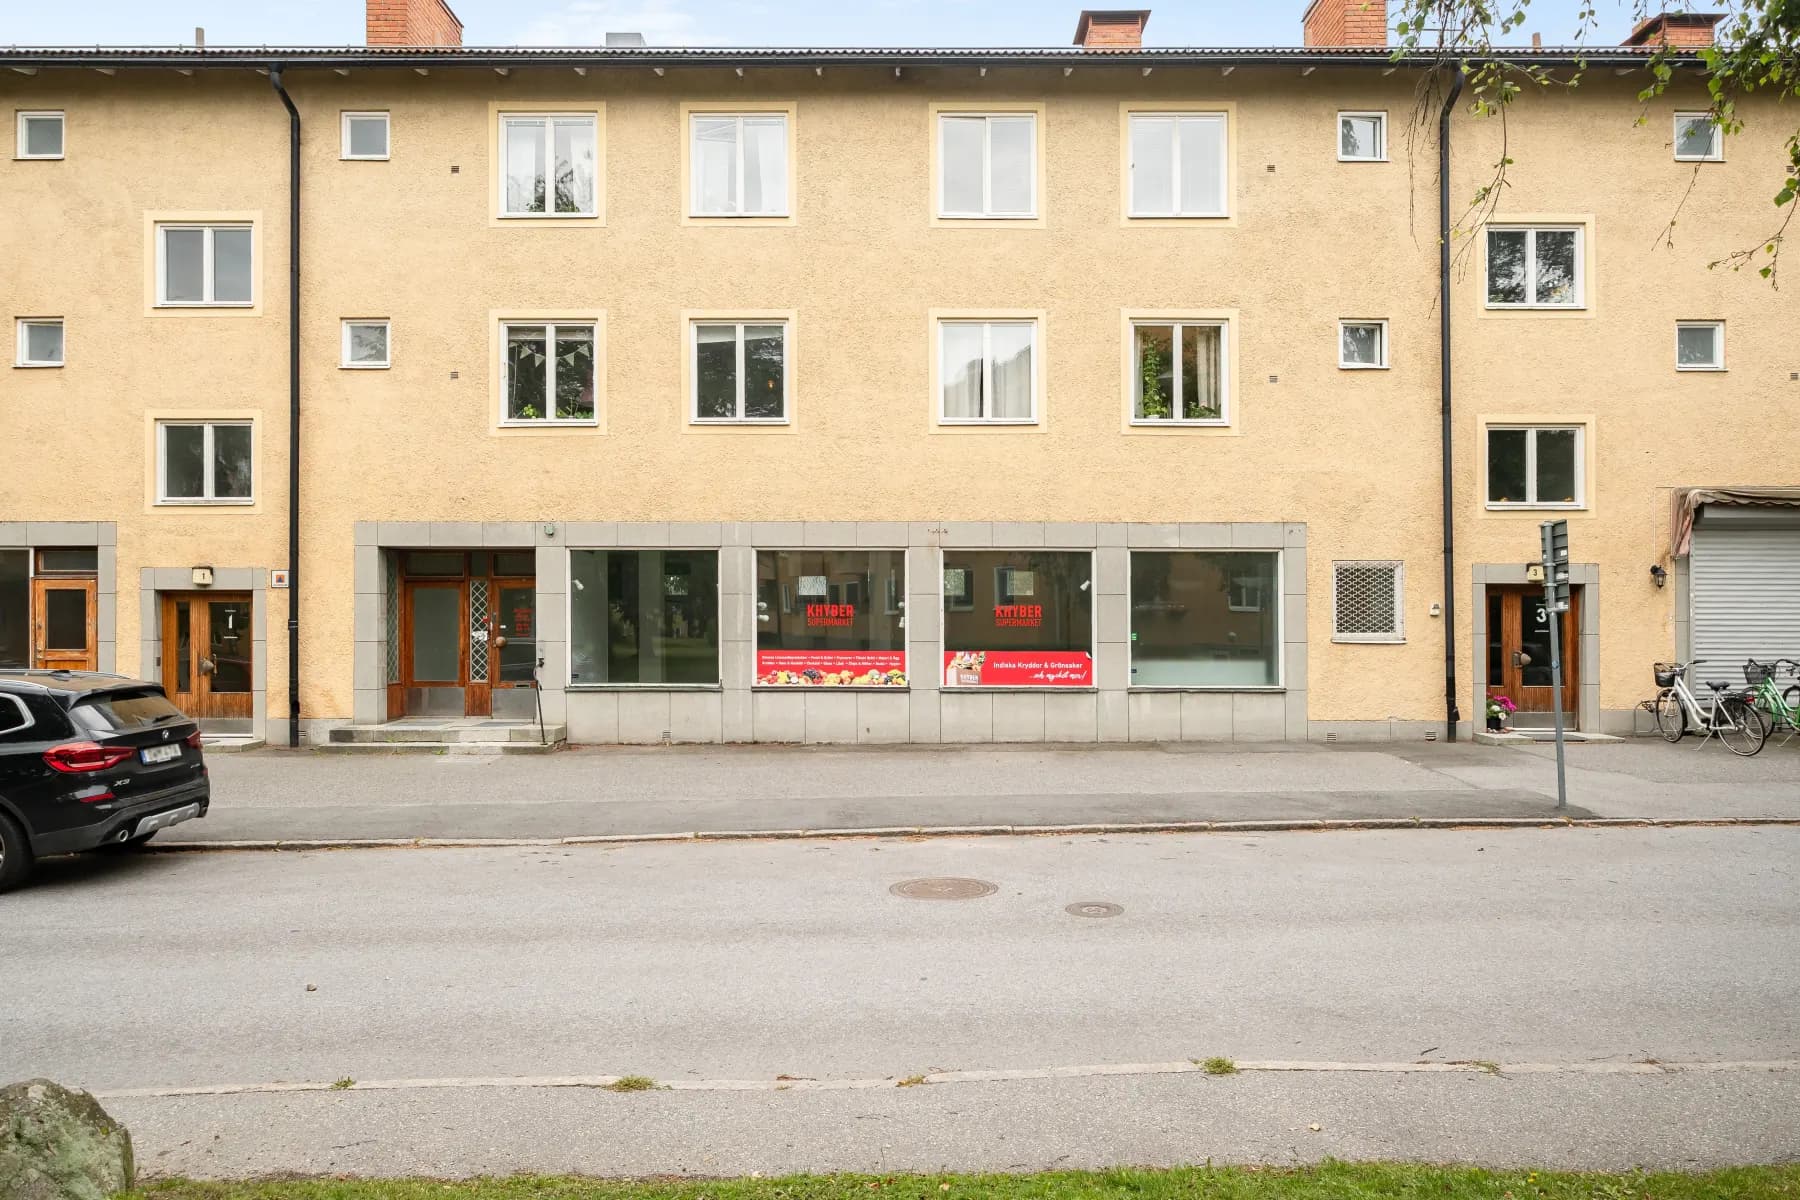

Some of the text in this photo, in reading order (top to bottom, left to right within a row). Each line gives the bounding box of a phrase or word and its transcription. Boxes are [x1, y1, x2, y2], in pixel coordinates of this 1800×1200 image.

[1533, 568, 1538, 576] 3
[807, 604, 854, 617] KHYBER
[995, 605, 1042, 617] KHYBER
[1536, 608, 1547, 622] 3
[228, 614, 233, 629] 1
[807, 617, 854, 626] SUPERMARKET
[995, 618, 1042, 627] SUPERMARKET
[993, 661, 1083, 670] Indiska Kryddor & Grönsaker
